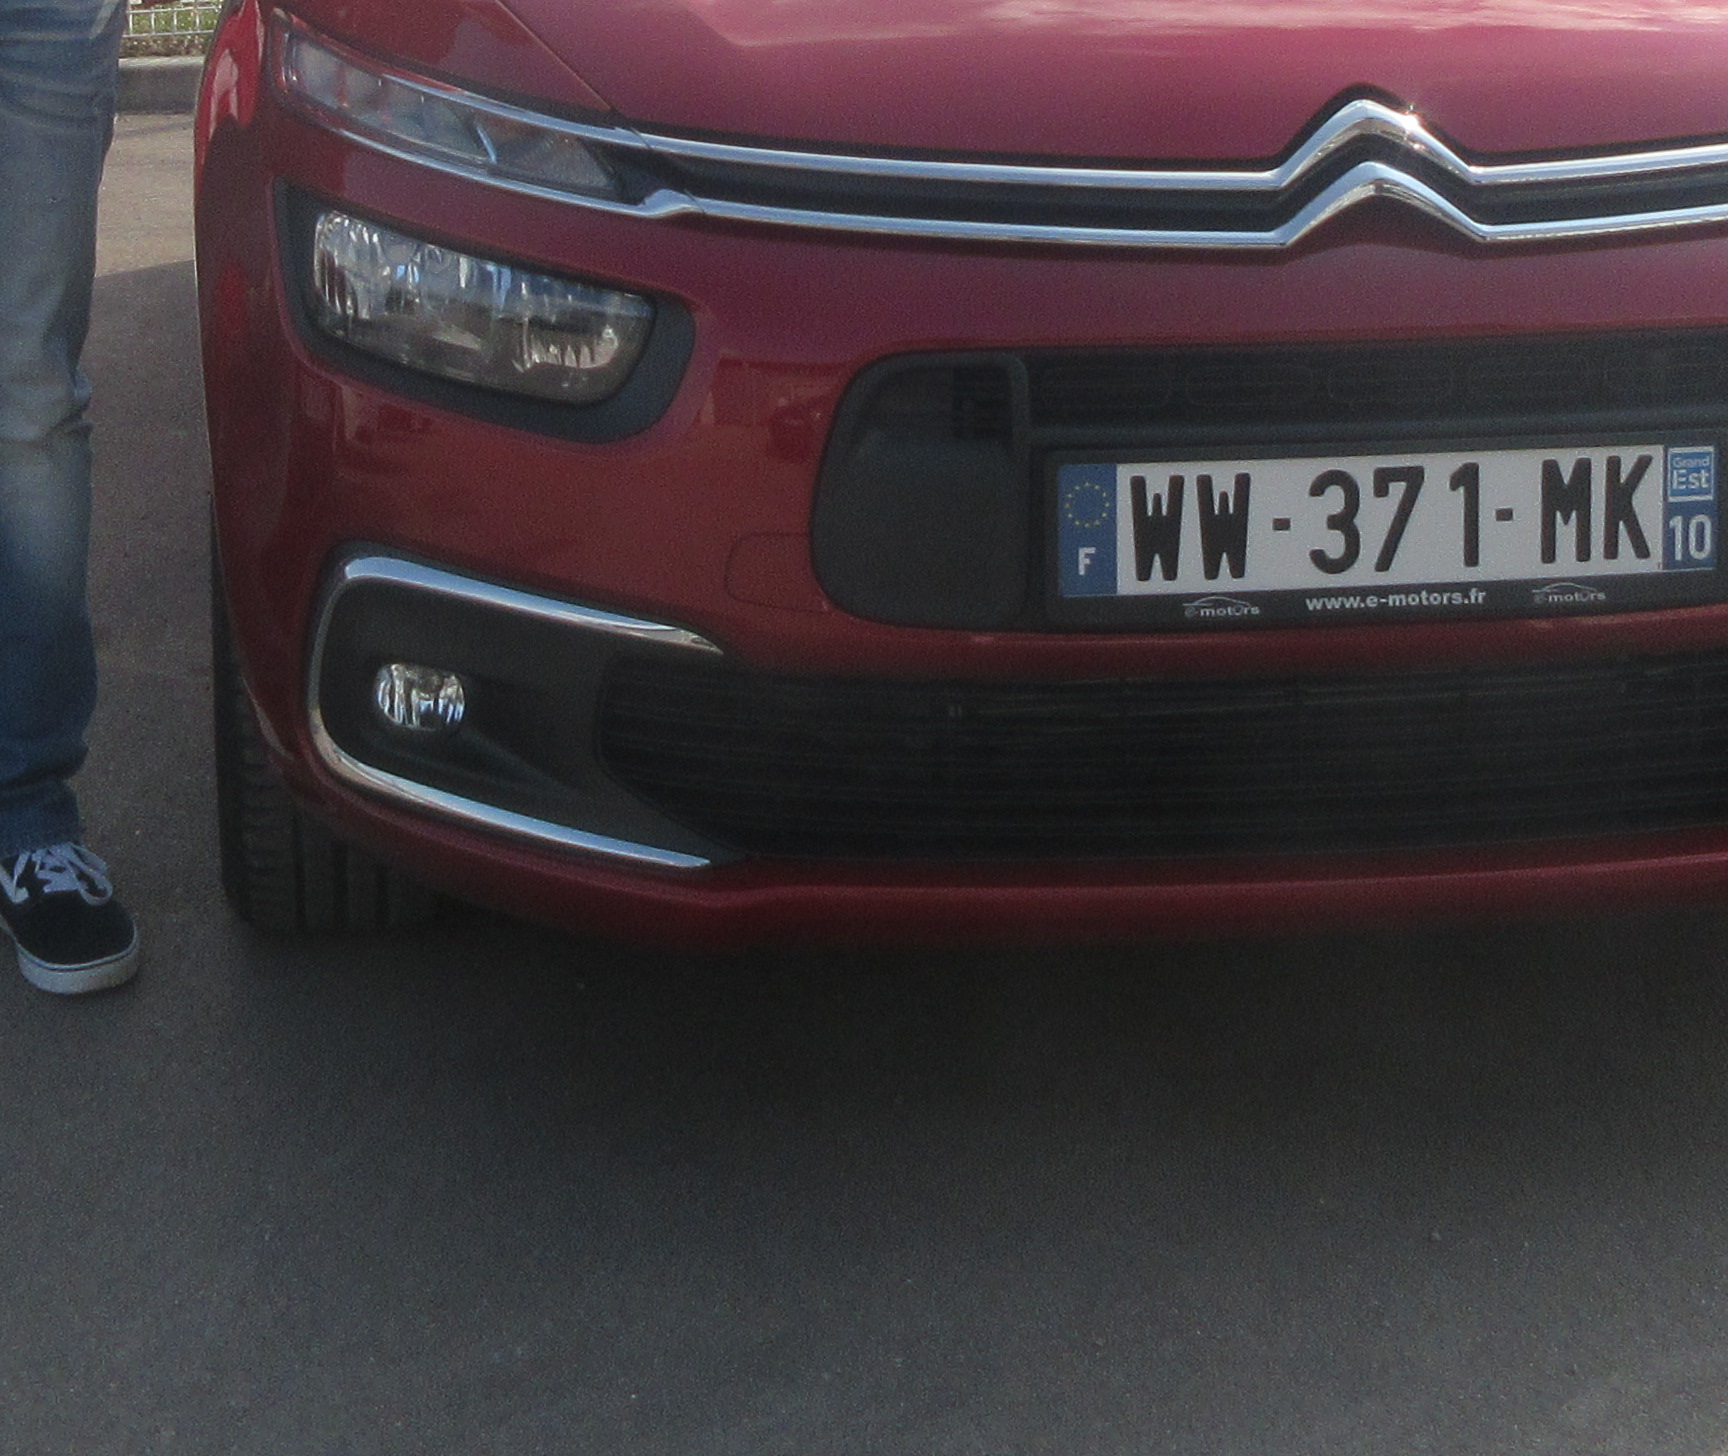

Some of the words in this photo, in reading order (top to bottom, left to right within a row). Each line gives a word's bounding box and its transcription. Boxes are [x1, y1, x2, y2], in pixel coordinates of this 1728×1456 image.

[1673, 455, 1710, 468] Grand
[1673, 469, 1710, 490] Est
[1129, 455, 1653, 582] WW-371-MK
[1669, 514, 1712, 561] 10
[1078, 547, 1097, 576] F
[1305, 587, 1487, 612] www.e-motors.fr
